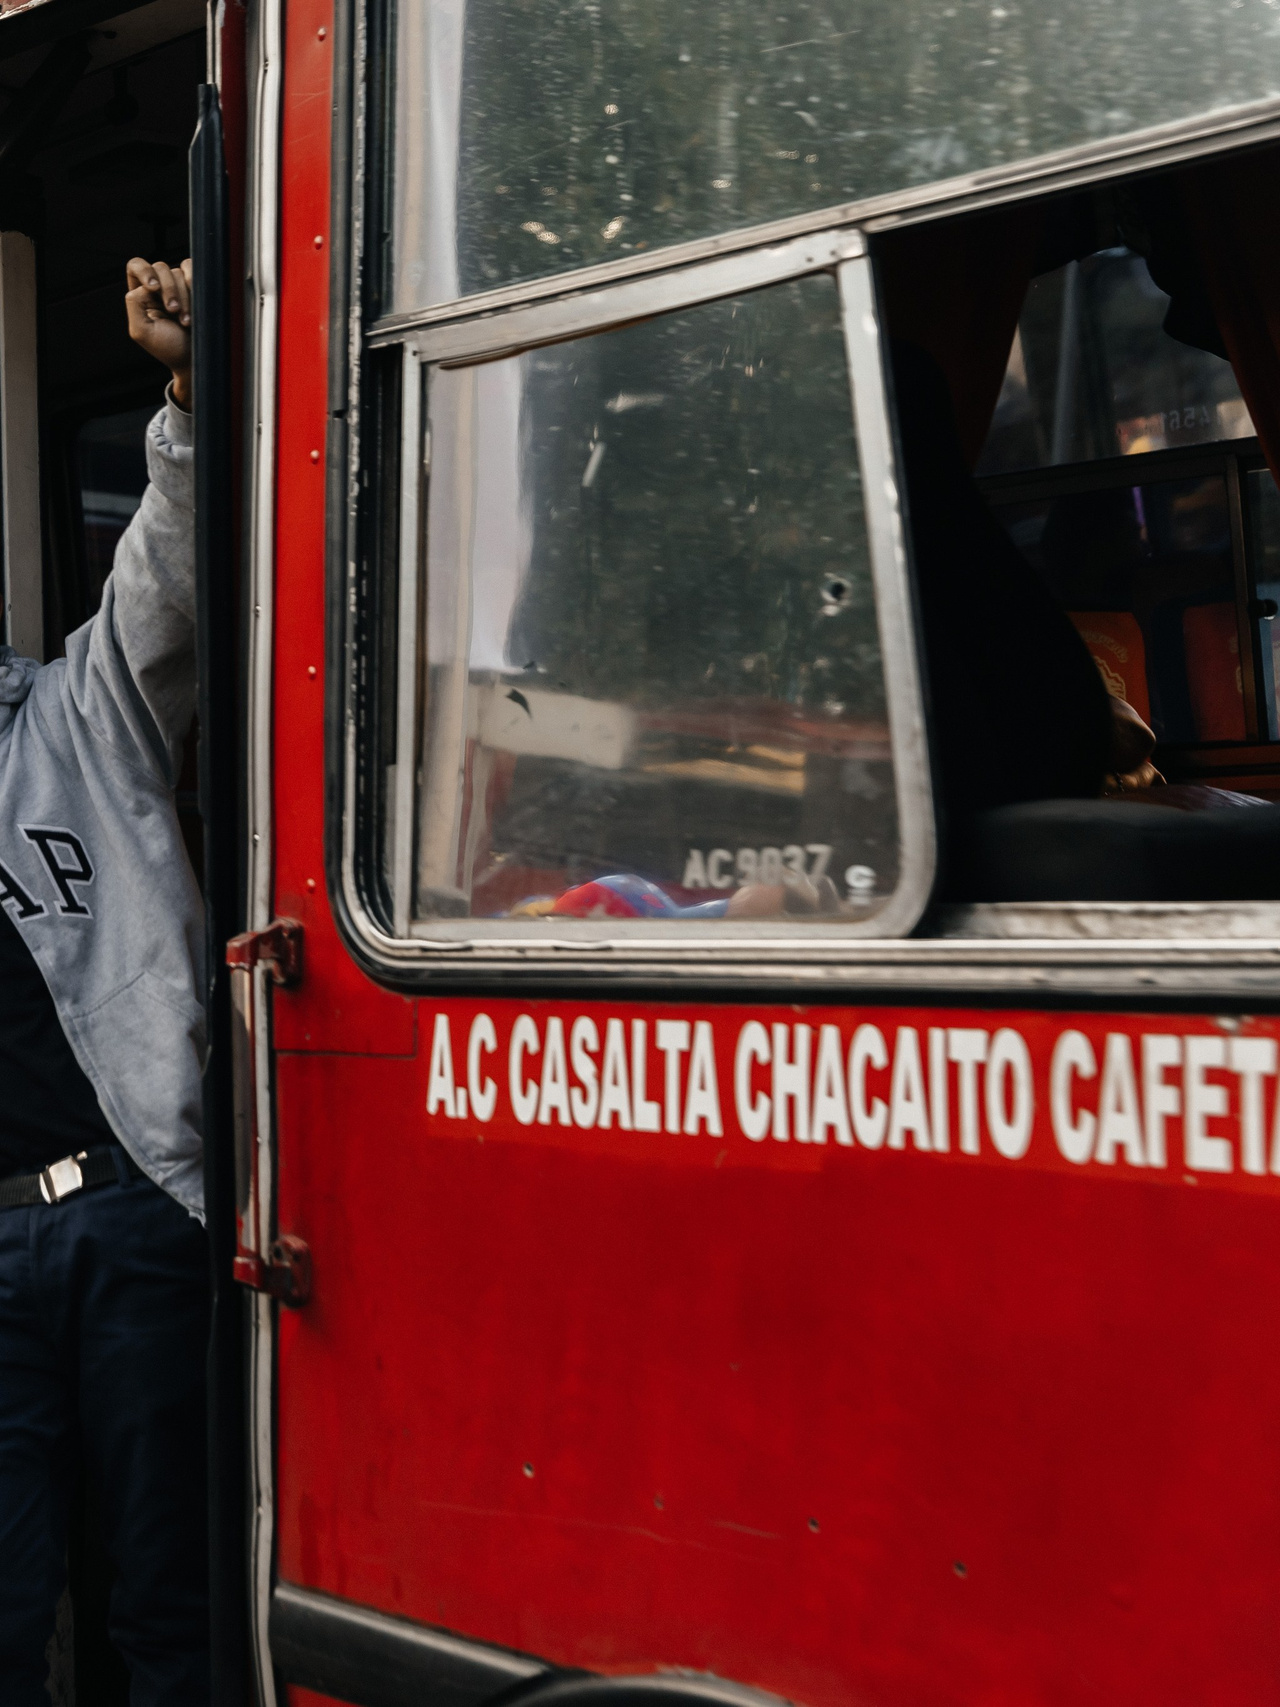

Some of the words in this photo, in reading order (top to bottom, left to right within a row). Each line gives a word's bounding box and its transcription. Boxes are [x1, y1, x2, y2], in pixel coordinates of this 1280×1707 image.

[426, 1012, 499, 1123] A.C
[508, 1013, 724, 1138] CASALTA
[733, 1019, 1035, 1161] CHACAITO
[1049, 1028, 1280, 1178] CAFET
